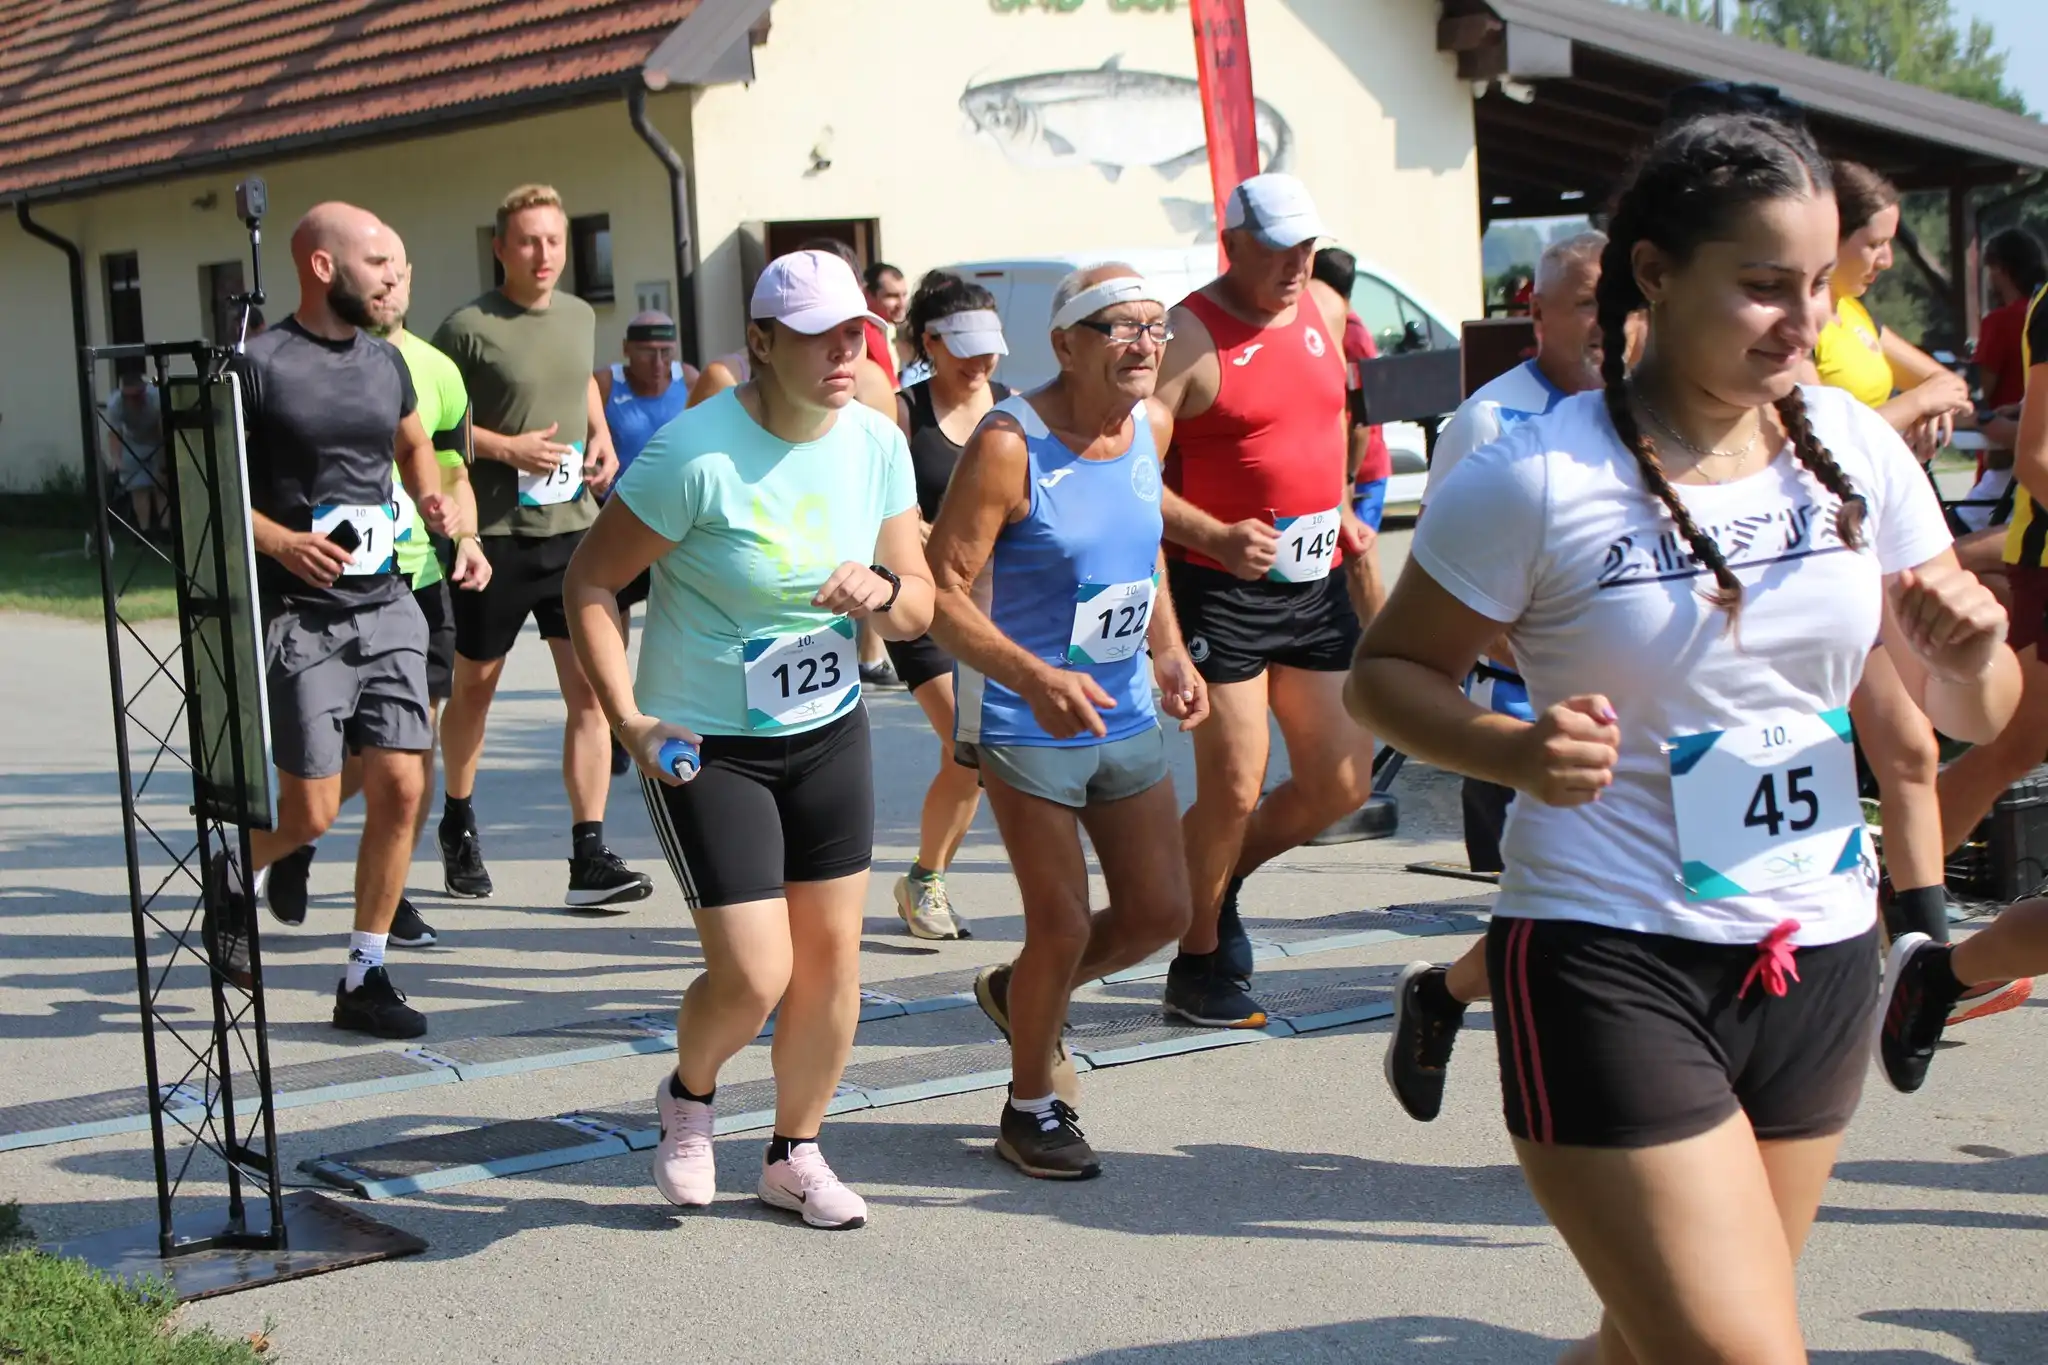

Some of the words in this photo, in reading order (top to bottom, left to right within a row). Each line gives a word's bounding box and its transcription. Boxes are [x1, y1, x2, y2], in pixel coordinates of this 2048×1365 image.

[1312, 515, 1324, 525] 10.
[1291, 528, 1336, 563] 149
[1098, 601, 1149, 639] 122
[797, 634, 815, 648] 10.
[771, 651, 841, 699] 123
[1761, 726, 1793, 748] 10.
[1743, 765, 1820, 837] 45
